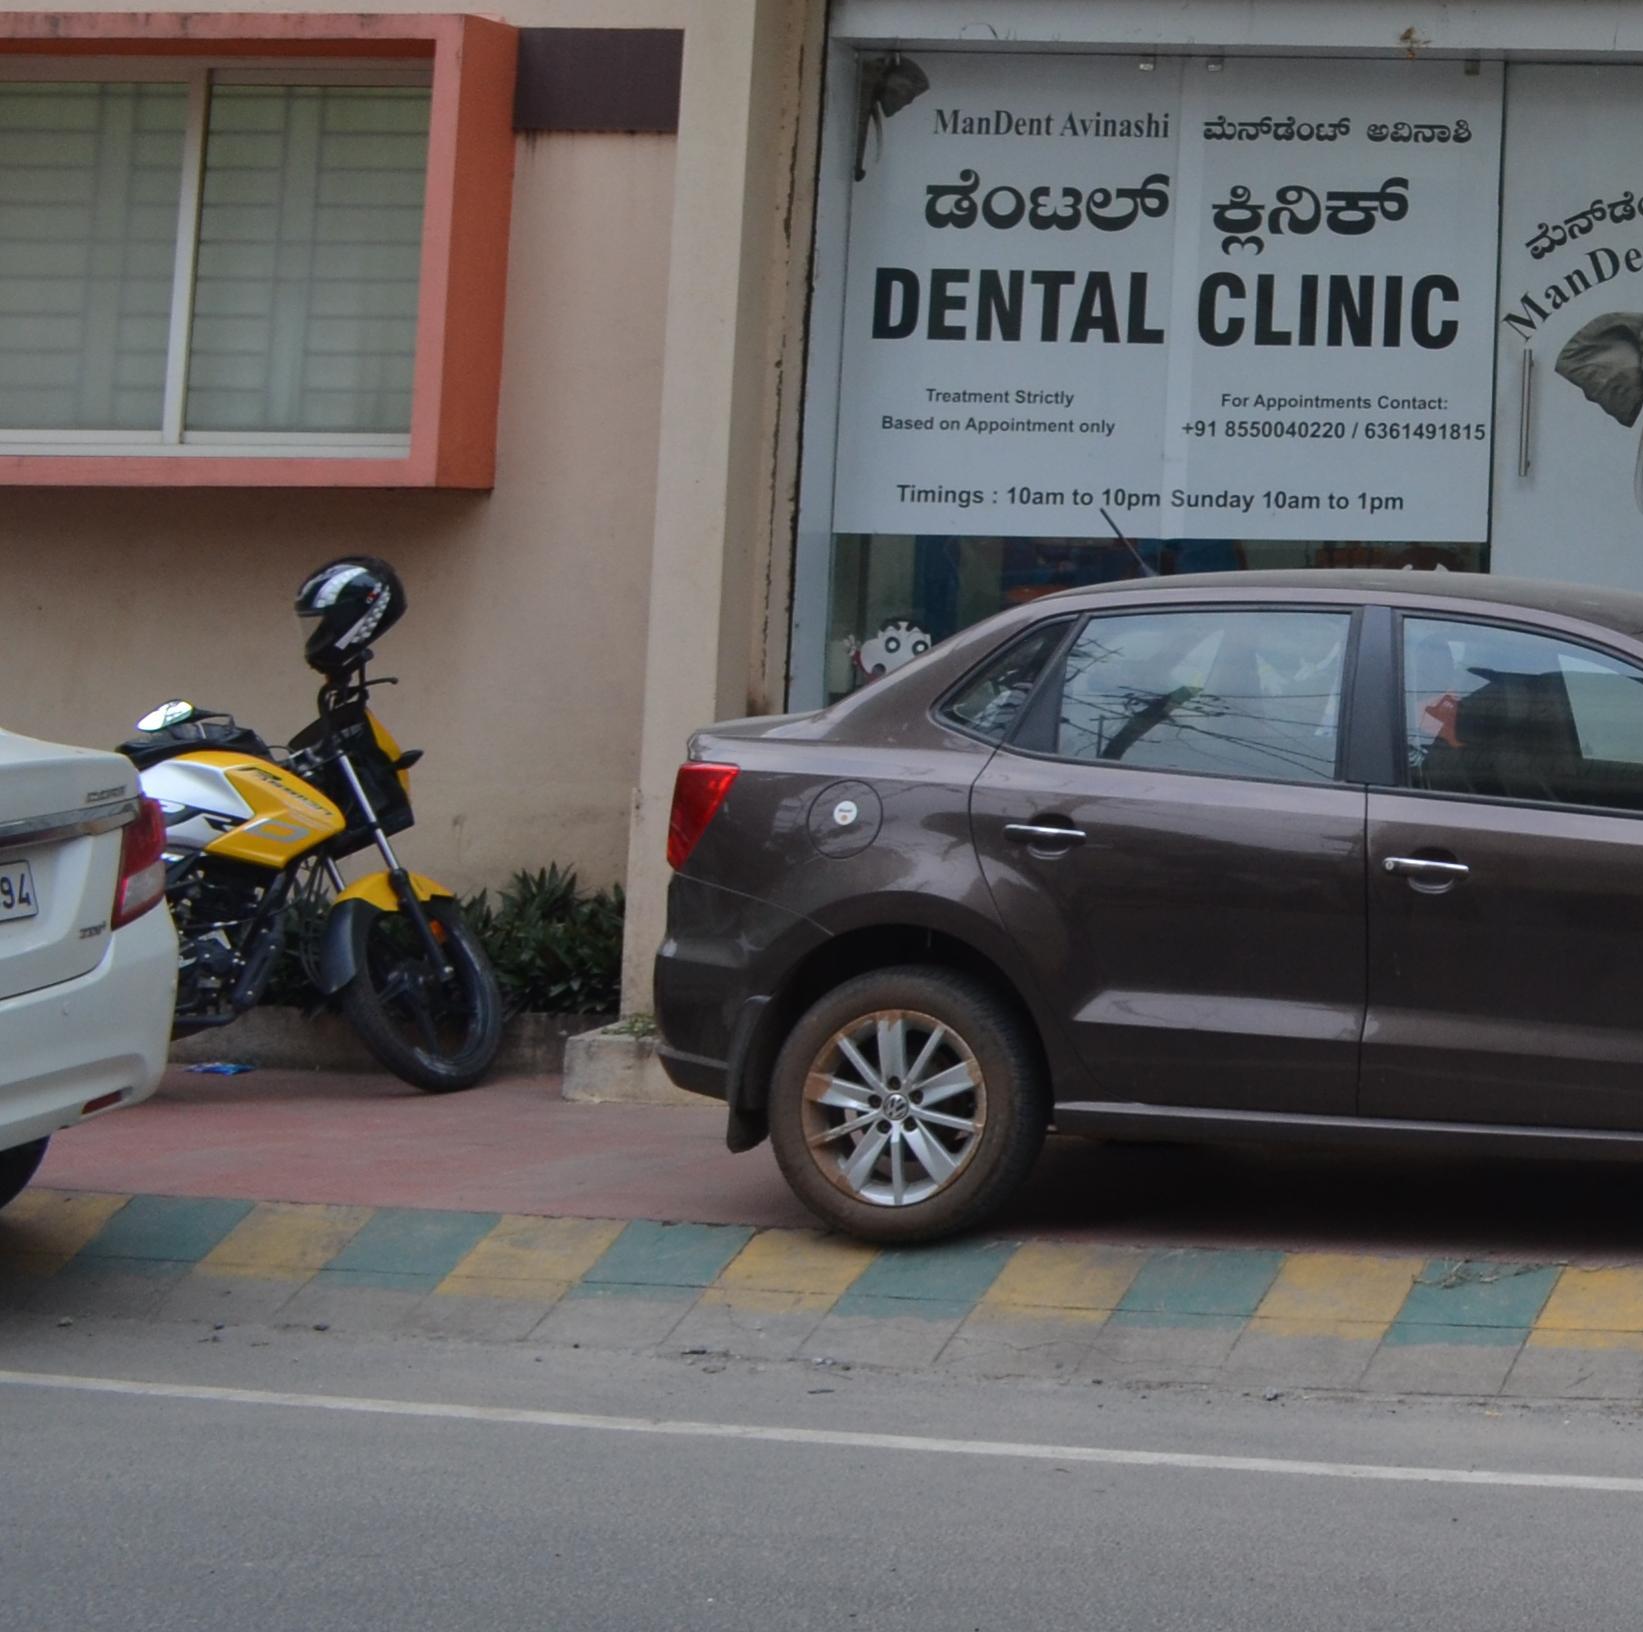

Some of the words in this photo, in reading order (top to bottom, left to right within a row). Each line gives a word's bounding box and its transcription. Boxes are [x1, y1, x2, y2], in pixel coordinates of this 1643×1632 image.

[934, 110, 1054, 138] ManDent
[1060, 113, 1169, 139] Avinashi
[1366, 119, 1472, 144] ಅವಿನಾಶಿ
[925, 169, 1170, 231] ಡೆಂಟಲ್
[1212, 176, 1409, 256] ಕ್ಲಿನಿಕ್
[872, 267, 1165, 344] DENTAL
[1200, 271, 1460, 350] CLINIC
[926, 389, 1010, 405] Treatment
[1015, 390, 1074, 408] Strictly
[1221, 394, 1250, 408] For
[1254, 394, 1372, 412] Appointments
[1377, 395, 1448, 410] Contact:
[882, 416, 934, 431] Based
[965, 418, 1073, 435] Appointment
[1079, 420, 1116, 436] only
[1182, 422, 1216, 438] +91
[1224, 422, 1346, 439] 8550040220
[1364, 422, 1486, 440] 6361491815
[898, 484, 984, 508] Timings
[1007, 488, 1064, 505] 10am
[1102, 489, 1161, 510] 10pm
[1171, 490, 1255, 514] Sunday
[1263, 492, 1320, 510] 10am
[1358, 493, 1403, 514] 1pm
